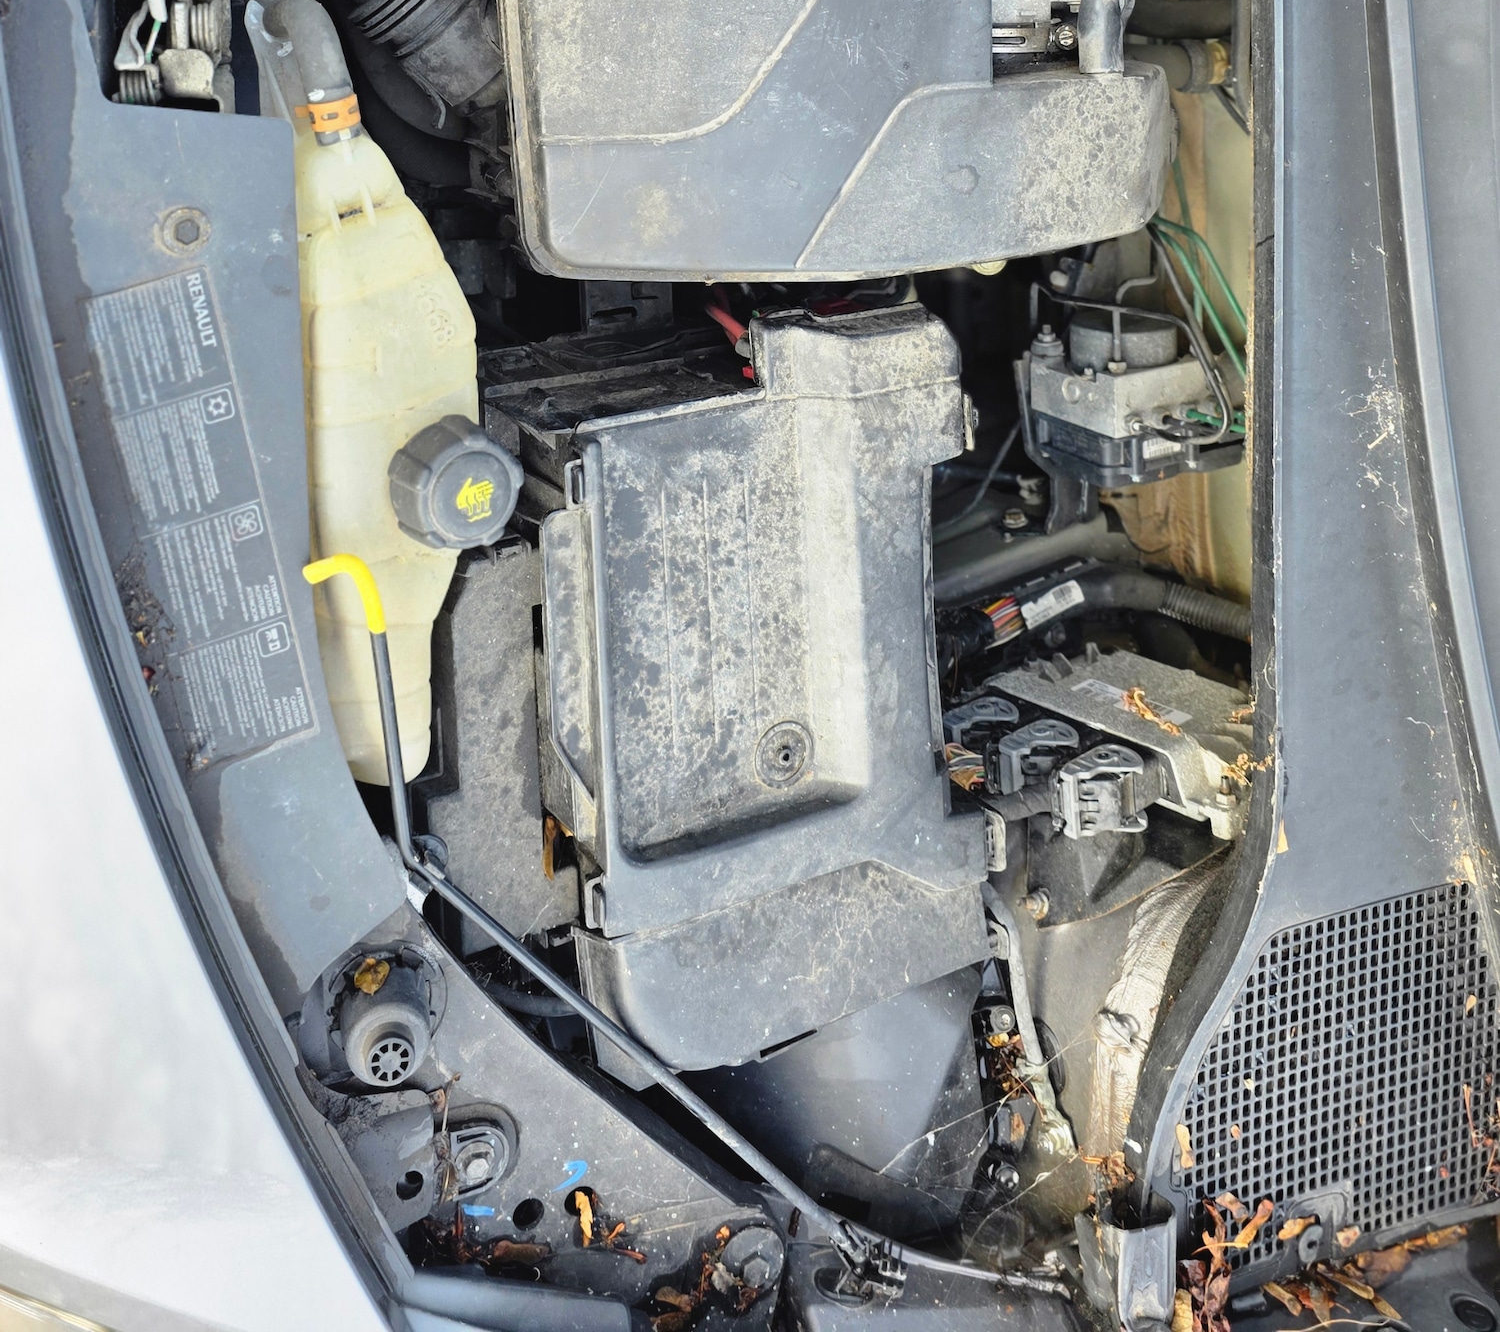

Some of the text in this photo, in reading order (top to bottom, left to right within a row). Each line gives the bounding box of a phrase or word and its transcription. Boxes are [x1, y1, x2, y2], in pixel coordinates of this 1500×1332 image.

[185, 271, 217, 349] RENAULT
[253, 583, 267, 619] ACHTUNG
[261, 583, 275, 617] CAUTION
[267, 573, 282, 614] ATTENTION
[272, 696, 286, 733] ATENCION
[280, 694, 294, 730] ACHTUNG
[289, 694, 302, 727] CAUTION
[294, 685, 310, 724] ATTENTION
